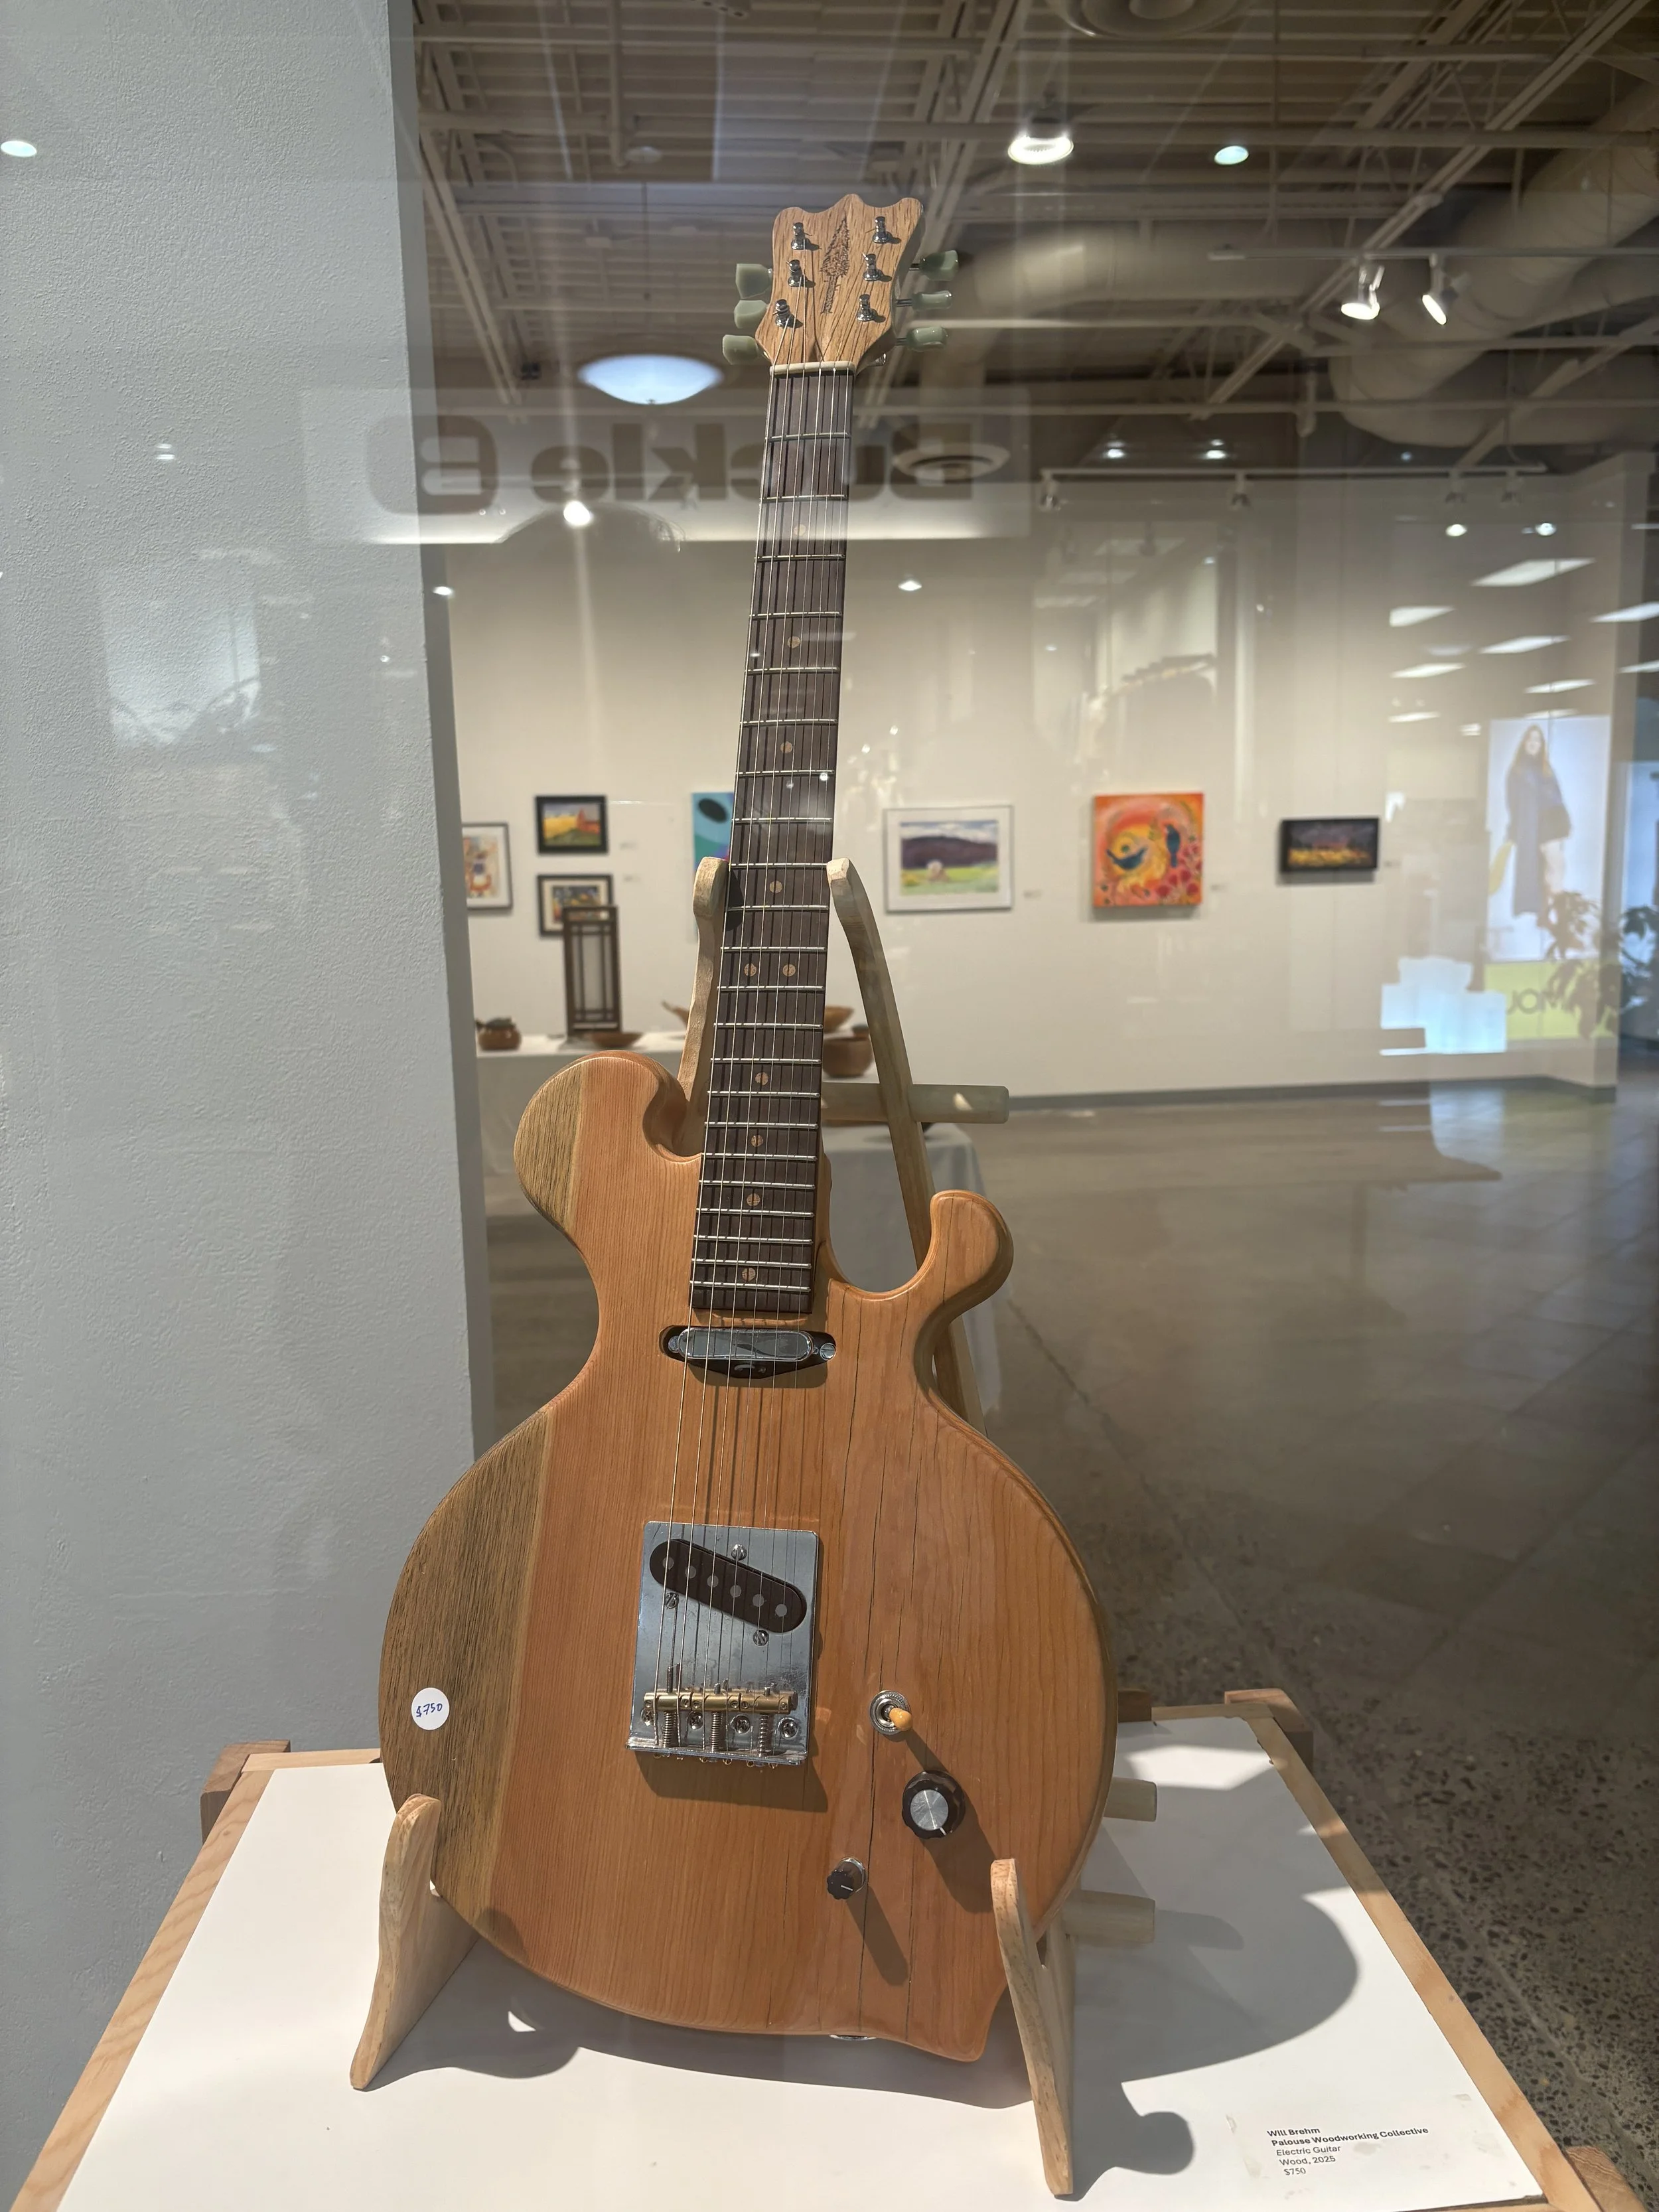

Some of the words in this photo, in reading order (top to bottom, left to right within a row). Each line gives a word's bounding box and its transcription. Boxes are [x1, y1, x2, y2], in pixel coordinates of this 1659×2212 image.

[416, 1703, 443, 1718] $750
[1311, 2132, 1380, 2144] Woodworking
[1380, 2128, 1429, 2138] Collective
[1276, 2148, 1311, 2156] Electric
[1283, 2167, 1306, 2176] $750
